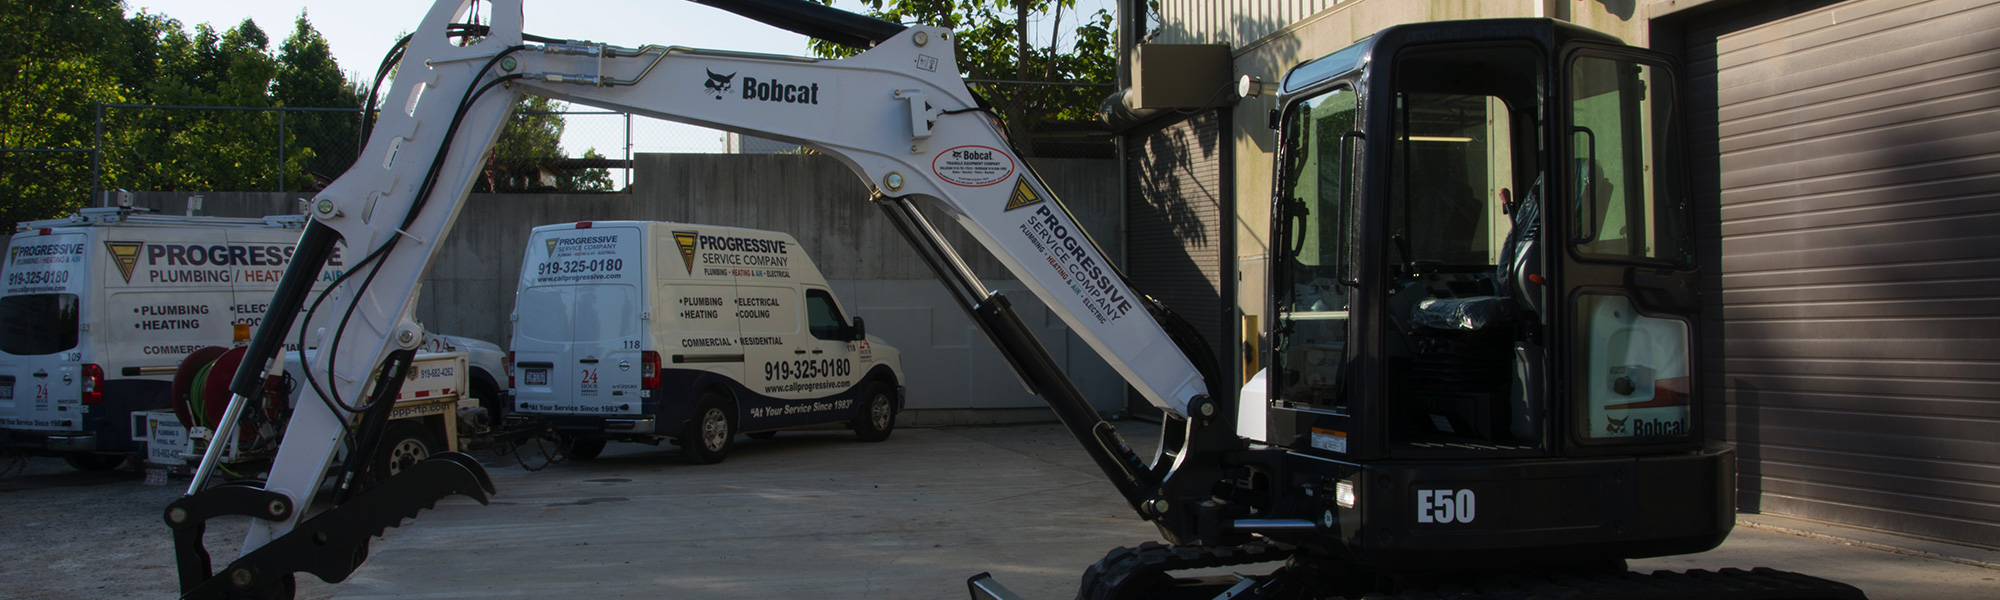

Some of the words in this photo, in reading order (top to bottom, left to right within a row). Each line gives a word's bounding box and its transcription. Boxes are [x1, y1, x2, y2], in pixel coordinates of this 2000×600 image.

[742, 77, 818, 104] Bobcat
[964, 151, 992, 160] Bobcat
[559, 235, 618, 245] PROGRESSIVE
[700, 235, 787, 254] PROGRESSIVE
[18, 243, 84, 257] PROGRESSIVE
[702, 253, 741, 265] SERVICE
[744, 255, 788, 267] COMPANY
[1036, 204, 1132, 316] PROGRESSIVE
[538, 258, 623, 275] 919-325-0180
[704, 268, 727, 276] PLUMBING
[1027, 216, 1070, 264] SERVICE
[1069, 263, 1121, 321] COMPANY
[9, 270, 69, 285] 919-325-0180
[150, 270, 230, 282] PLUMBING
[235, 270, 240, 283] /
[537, 273, 621, 282] www.callprogressive.com
[1020, 224, 1045, 253] PLUMBING
[1047, 255, 1069, 280] HEATING
[1071, 284, 1082, 295] AIR
[1083, 297, 1107, 324] ELECTRIC
[683, 297, 723, 306] PLUMBING
[738, 298, 779, 306] ELECTRICAL
[141, 305, 209, 316] PLUMBING
[685, 310, 718, 319] HEATING
[739, 310, 770, 318] COOLING
[142, 319, 200, 330] HEATING
[624, 340, 641, 349] 118
[682, 338, 732, 347] COMMERCIAL
[740, 337, 783, 345] RESIDENTIAL
[847, 344, 856, 352] 118
[143, 344, 205, 355] COMMERC
[67, 352, 81, 361] 109
[581, 368, 598, 383] 24
[765, 358, 851, 381] 919-325-0180
[36, 383, 48, 399] 24
[765, 380, 850, 393] www.callprogressive.com
[555, 404, 577, 412] Service
[765, 406, 783, 417] Your
[784, 402, 811, 415] Service
[813, 401, 833, 412] Since
[1417, 489, 1475, 523] E50
